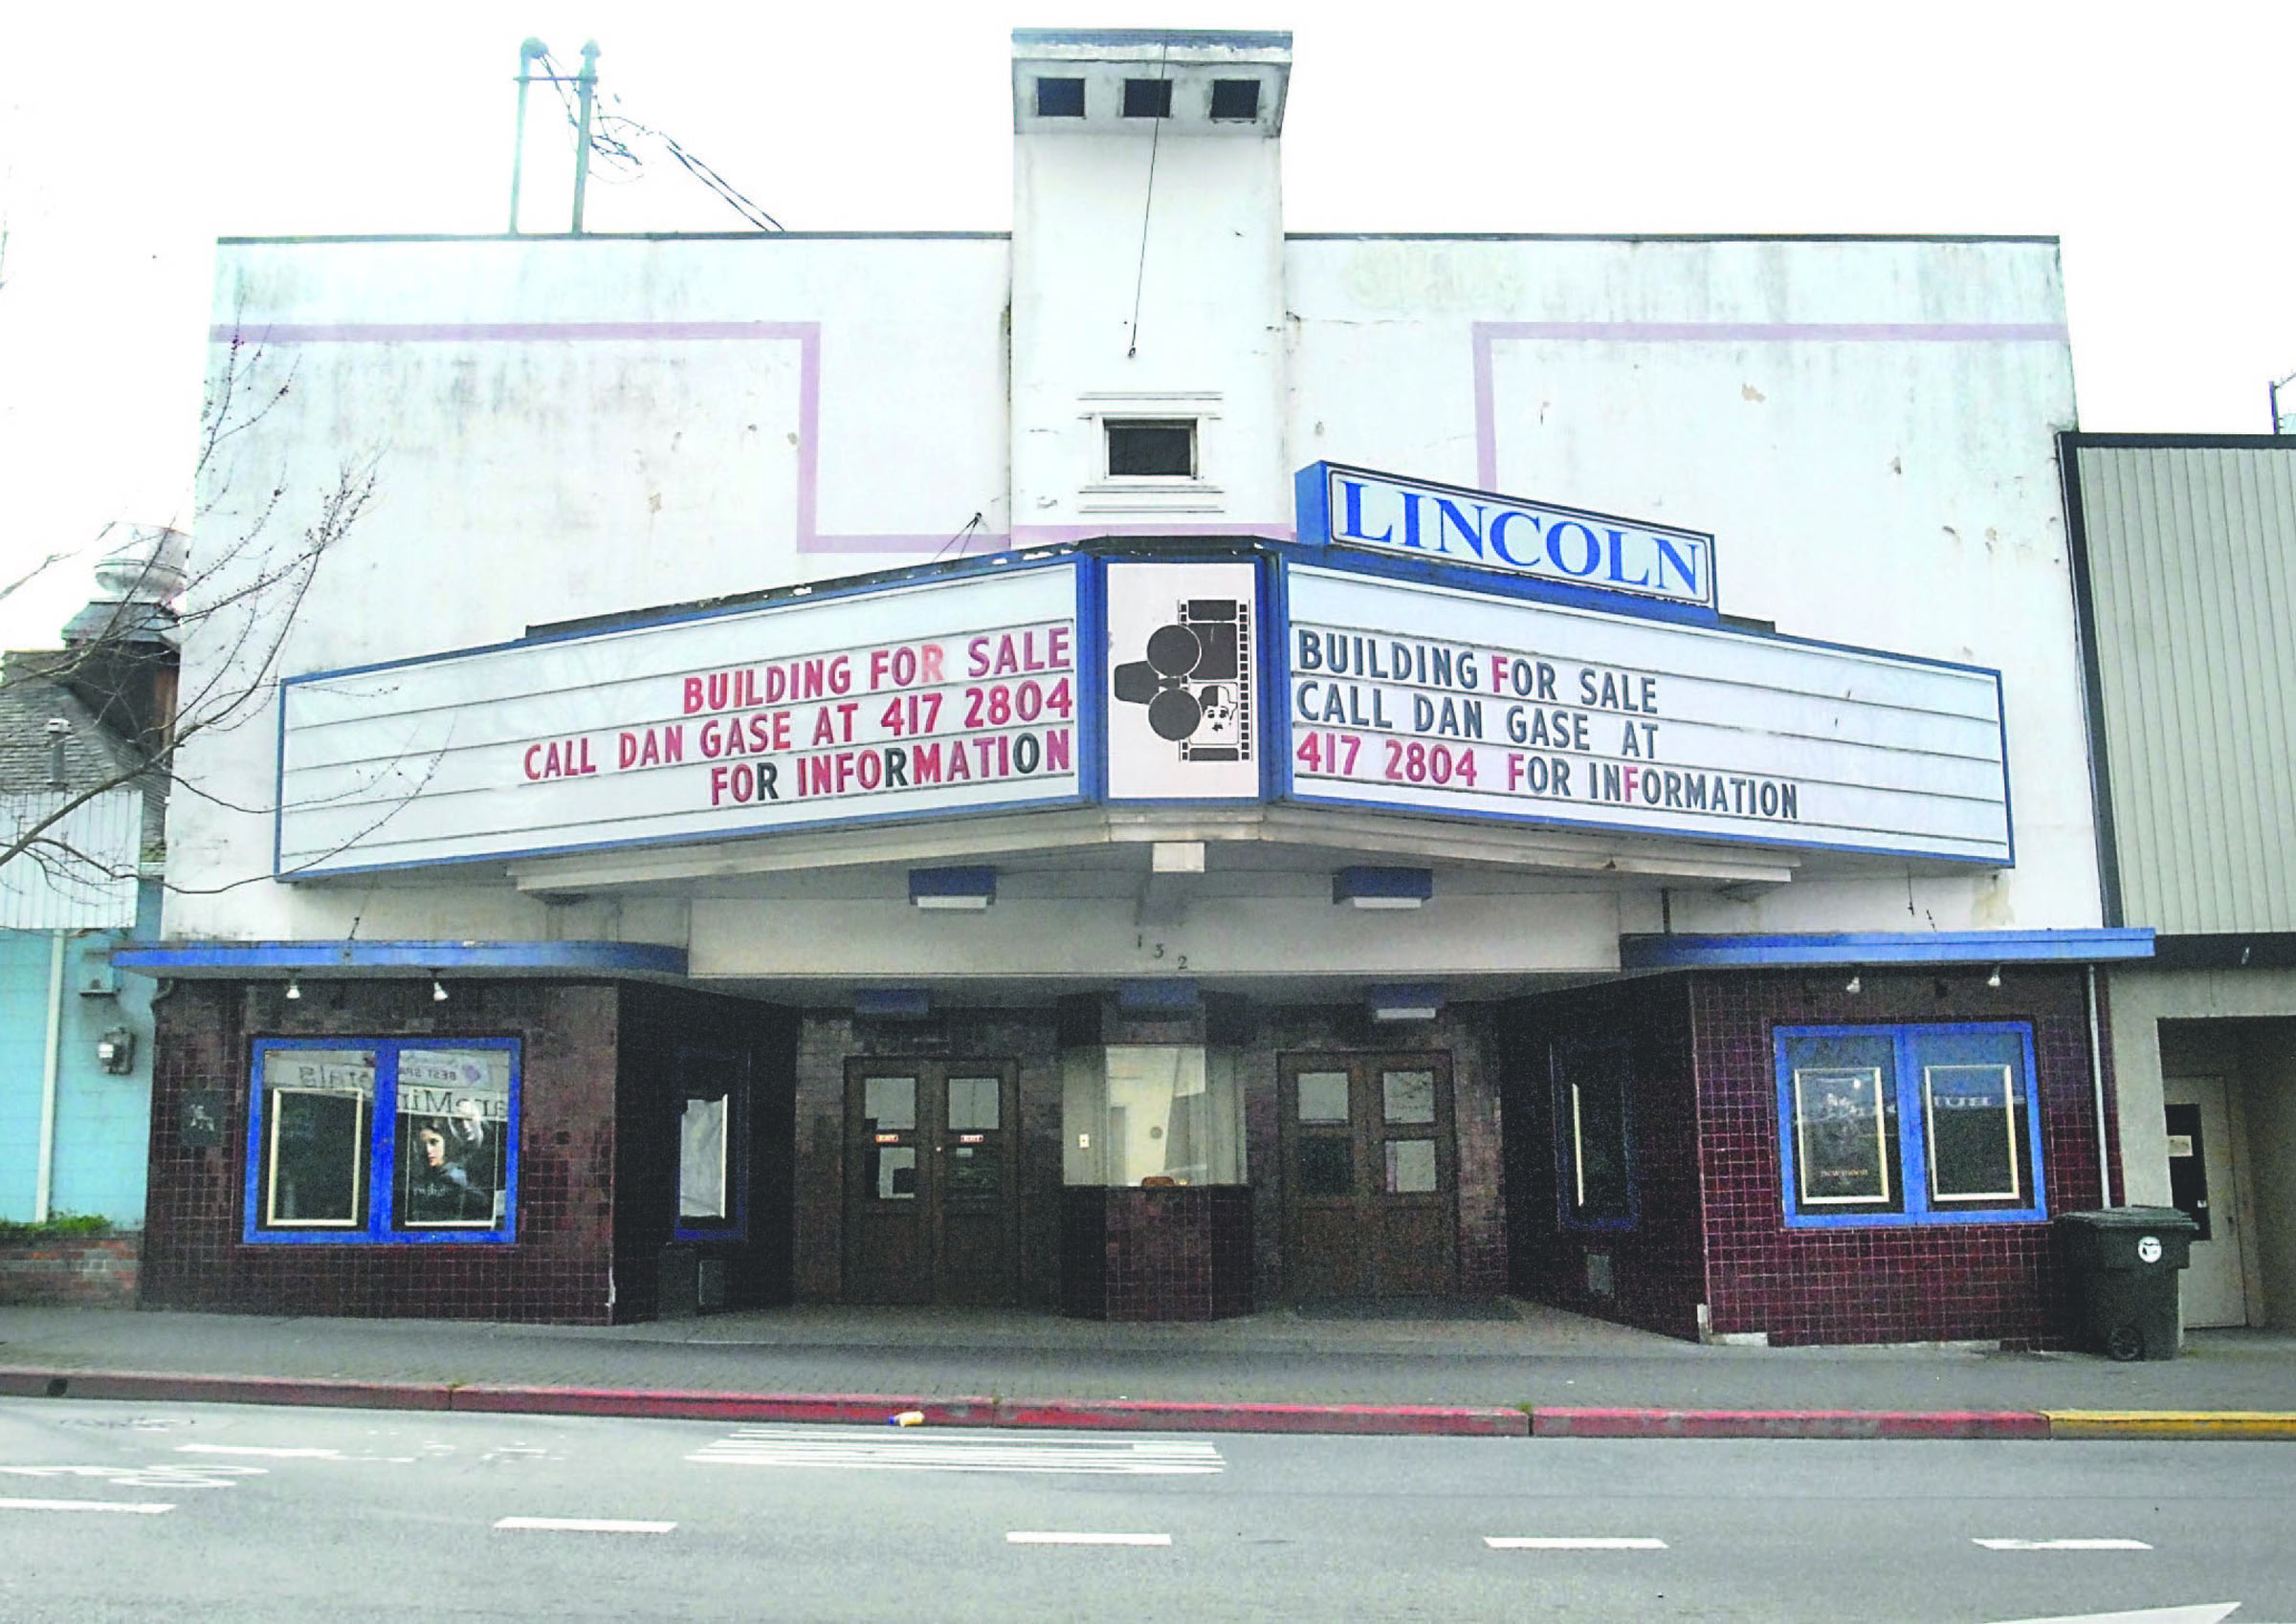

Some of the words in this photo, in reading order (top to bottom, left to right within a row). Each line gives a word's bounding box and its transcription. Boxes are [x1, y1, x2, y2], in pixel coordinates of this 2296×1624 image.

[1339, 480, 1699, 596] LINCOLN
[683, 655, 850, 715] BUILDING
[871, 643, 943, 690] FOR
[968, 626, 1071, 678] SALE
[1297, 628, 1478, 691] BUILDING
[1491, 654, 1557, 701] FOR
[1579, 668, 1659, 714] SALE
[524, 736, 597, 780] CALL
[619, 724, 683, 770] DAN
[699, 711, 791, 759] GASE
[812, 702, 859, 747] AT
[880, 691, 943, 737] 417
[964, 677, 1073, 730] 2804
[1296, 680, 1393, 730] CALL
[1414, 692, 1483, 739] DAN
[1506, 705, 1591, 752] GASE
[1621, 719, 1659, 759] AT
[711, 761, 780, 806] FOR
[796, 728, 1071, 798] INFORMATION
[1295, 731, 1361, 777] 417
[1384, 738, 1478, 787] 2804
[1508, 753, 1572, 798] FOR
[1588, 761, 1798, 820] INFORMATION
